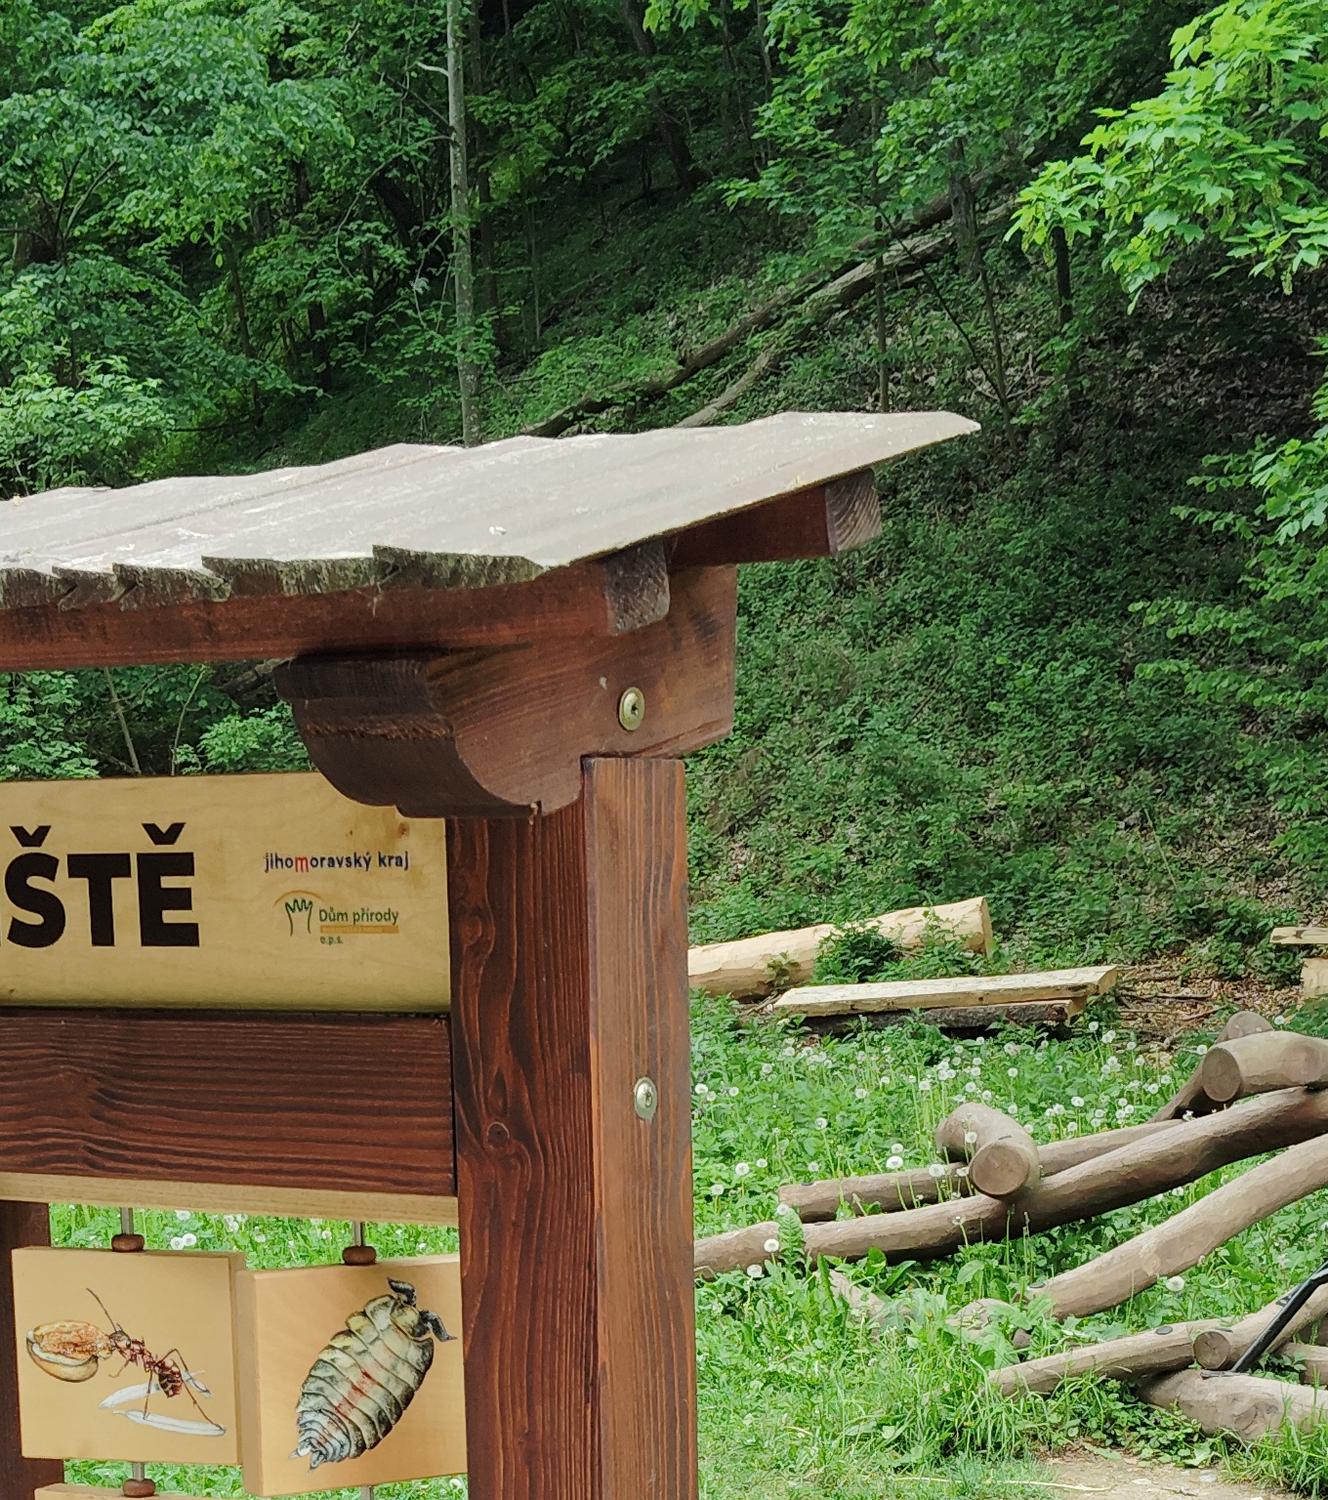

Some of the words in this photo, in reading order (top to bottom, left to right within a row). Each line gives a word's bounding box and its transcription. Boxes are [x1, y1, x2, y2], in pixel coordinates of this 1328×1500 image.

[265, 851, 371, 872] jihomoravský
[378, 850, 410, 870] kraj
[319, 907, 348, 921] Dům
[353, 908, 399, 925] přírody
